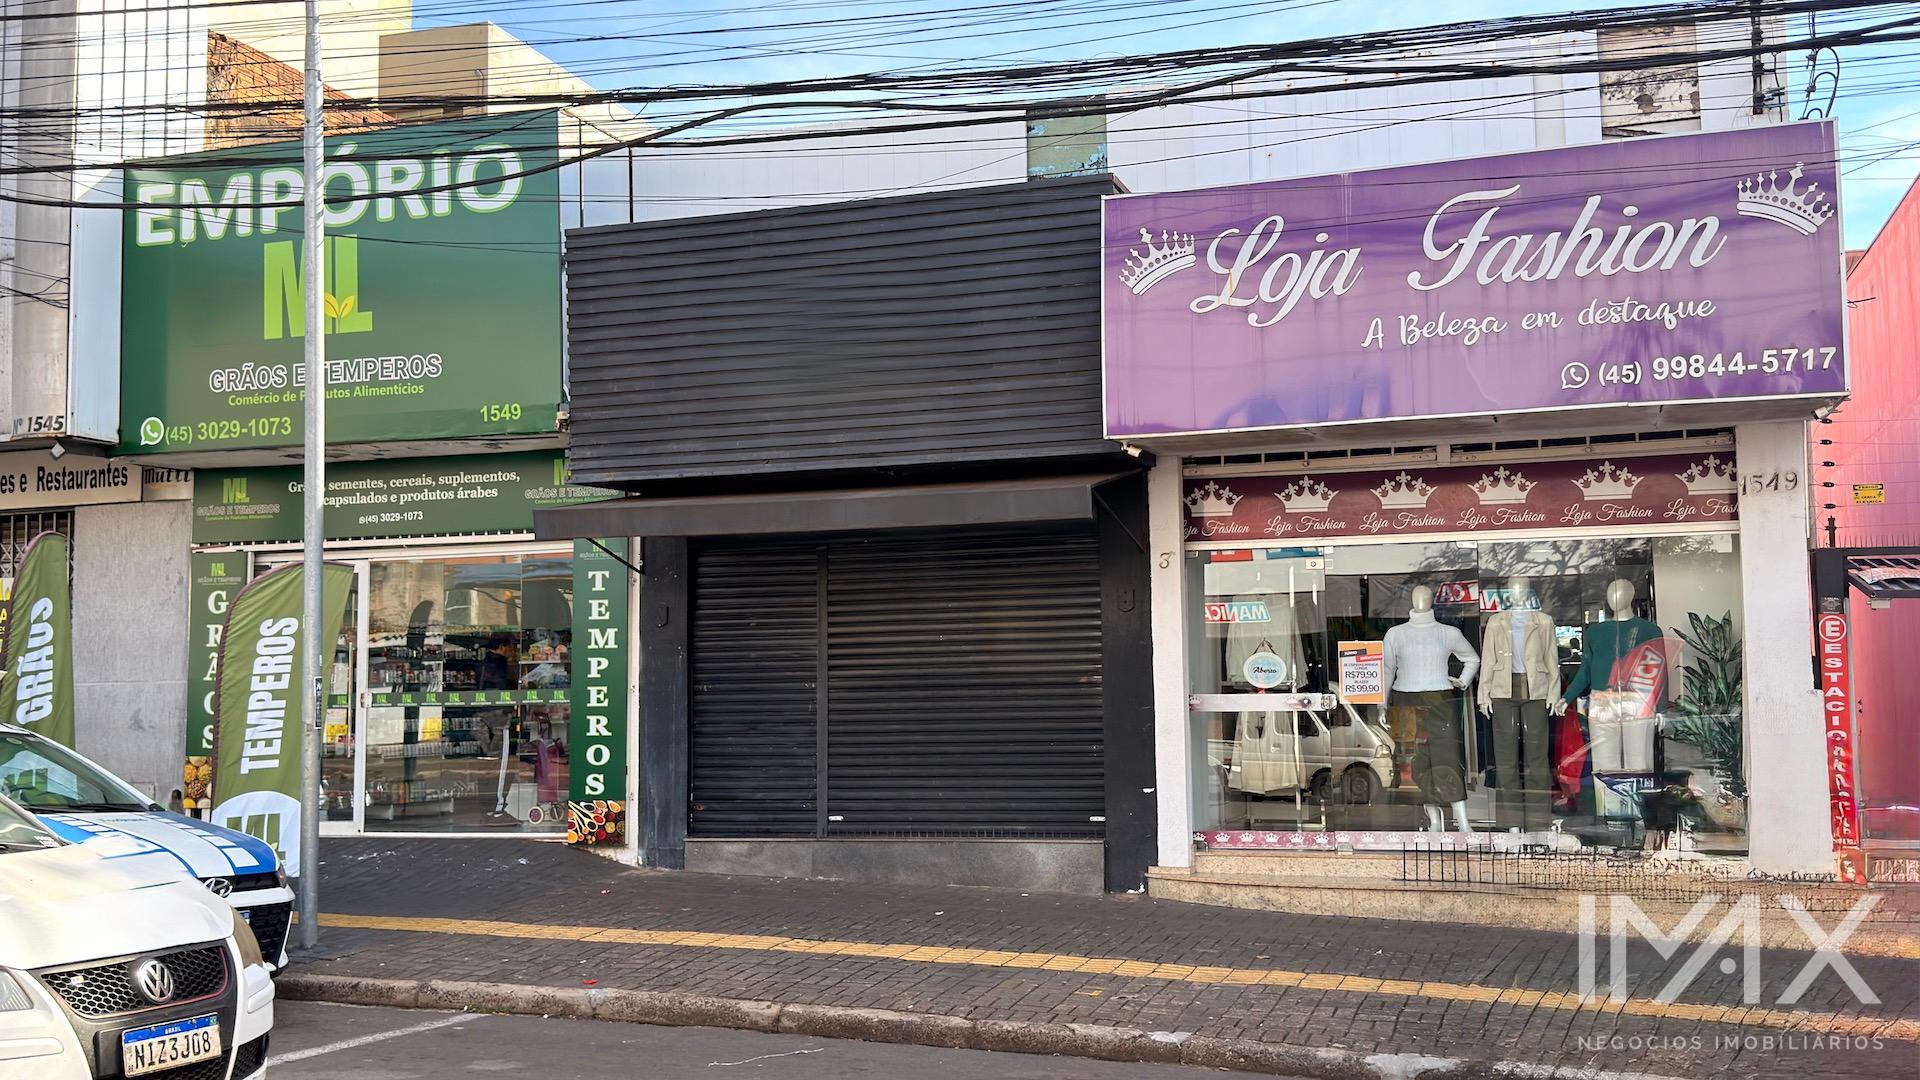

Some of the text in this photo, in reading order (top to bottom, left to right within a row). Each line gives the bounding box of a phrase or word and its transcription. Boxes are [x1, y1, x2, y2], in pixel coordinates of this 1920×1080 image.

[135, 141, 525, 248] EMPÓRIO
[1188, 183, 1728, 328] Loja Fashion
[264, 234, 374, 341] ML
[1361, 296, 1717, 350] A Beleza em destaque
[208, 362, 288, 393] GRÃOS
[324, 353, 443, 385] EMPEROS
[1598, 346, 1838, 386] (45) 99844-5717
[228, 382, 425, 406] Comércio de Putos Alimentícios
[27, 415, 65, 433] 1545
[479, 403, 522, 423] 1549
[164, 417, 292, 445] (45) 3029-1073
[19, 473, 28, 492] e
[37, 463, 129, 493] Restaurantes
[328, 477, 388, 493] sementes,
[390, 474, 436, 489] cereais,
[438, 469, 520, 486] suplementos,
[1738, 471, 1798, 496] 1549
[323, 485, 498, 508] capsulados e produtos árabes
[1663, 498, 1696, 520] Loja
[380, 510, 423, 523] 3029-1073
[1263, 515, 1347, 534] Loja Fashion
[1358, 511, 1446, 534] Loja Fashion
[1456, 506, 1546, 529] Loja Fashion
[1559, 503, 1653, 526] Loja Fashion
[1183, 519, 1251, 540] oja Fashion
[16, 597, 54, 725] GRÃOS
[240, 616, 299, 775] TEMPEROS
[584, 570, 619, 796] TEMPEROS
[134, 1030, 211, 1070] NIZ3J08
